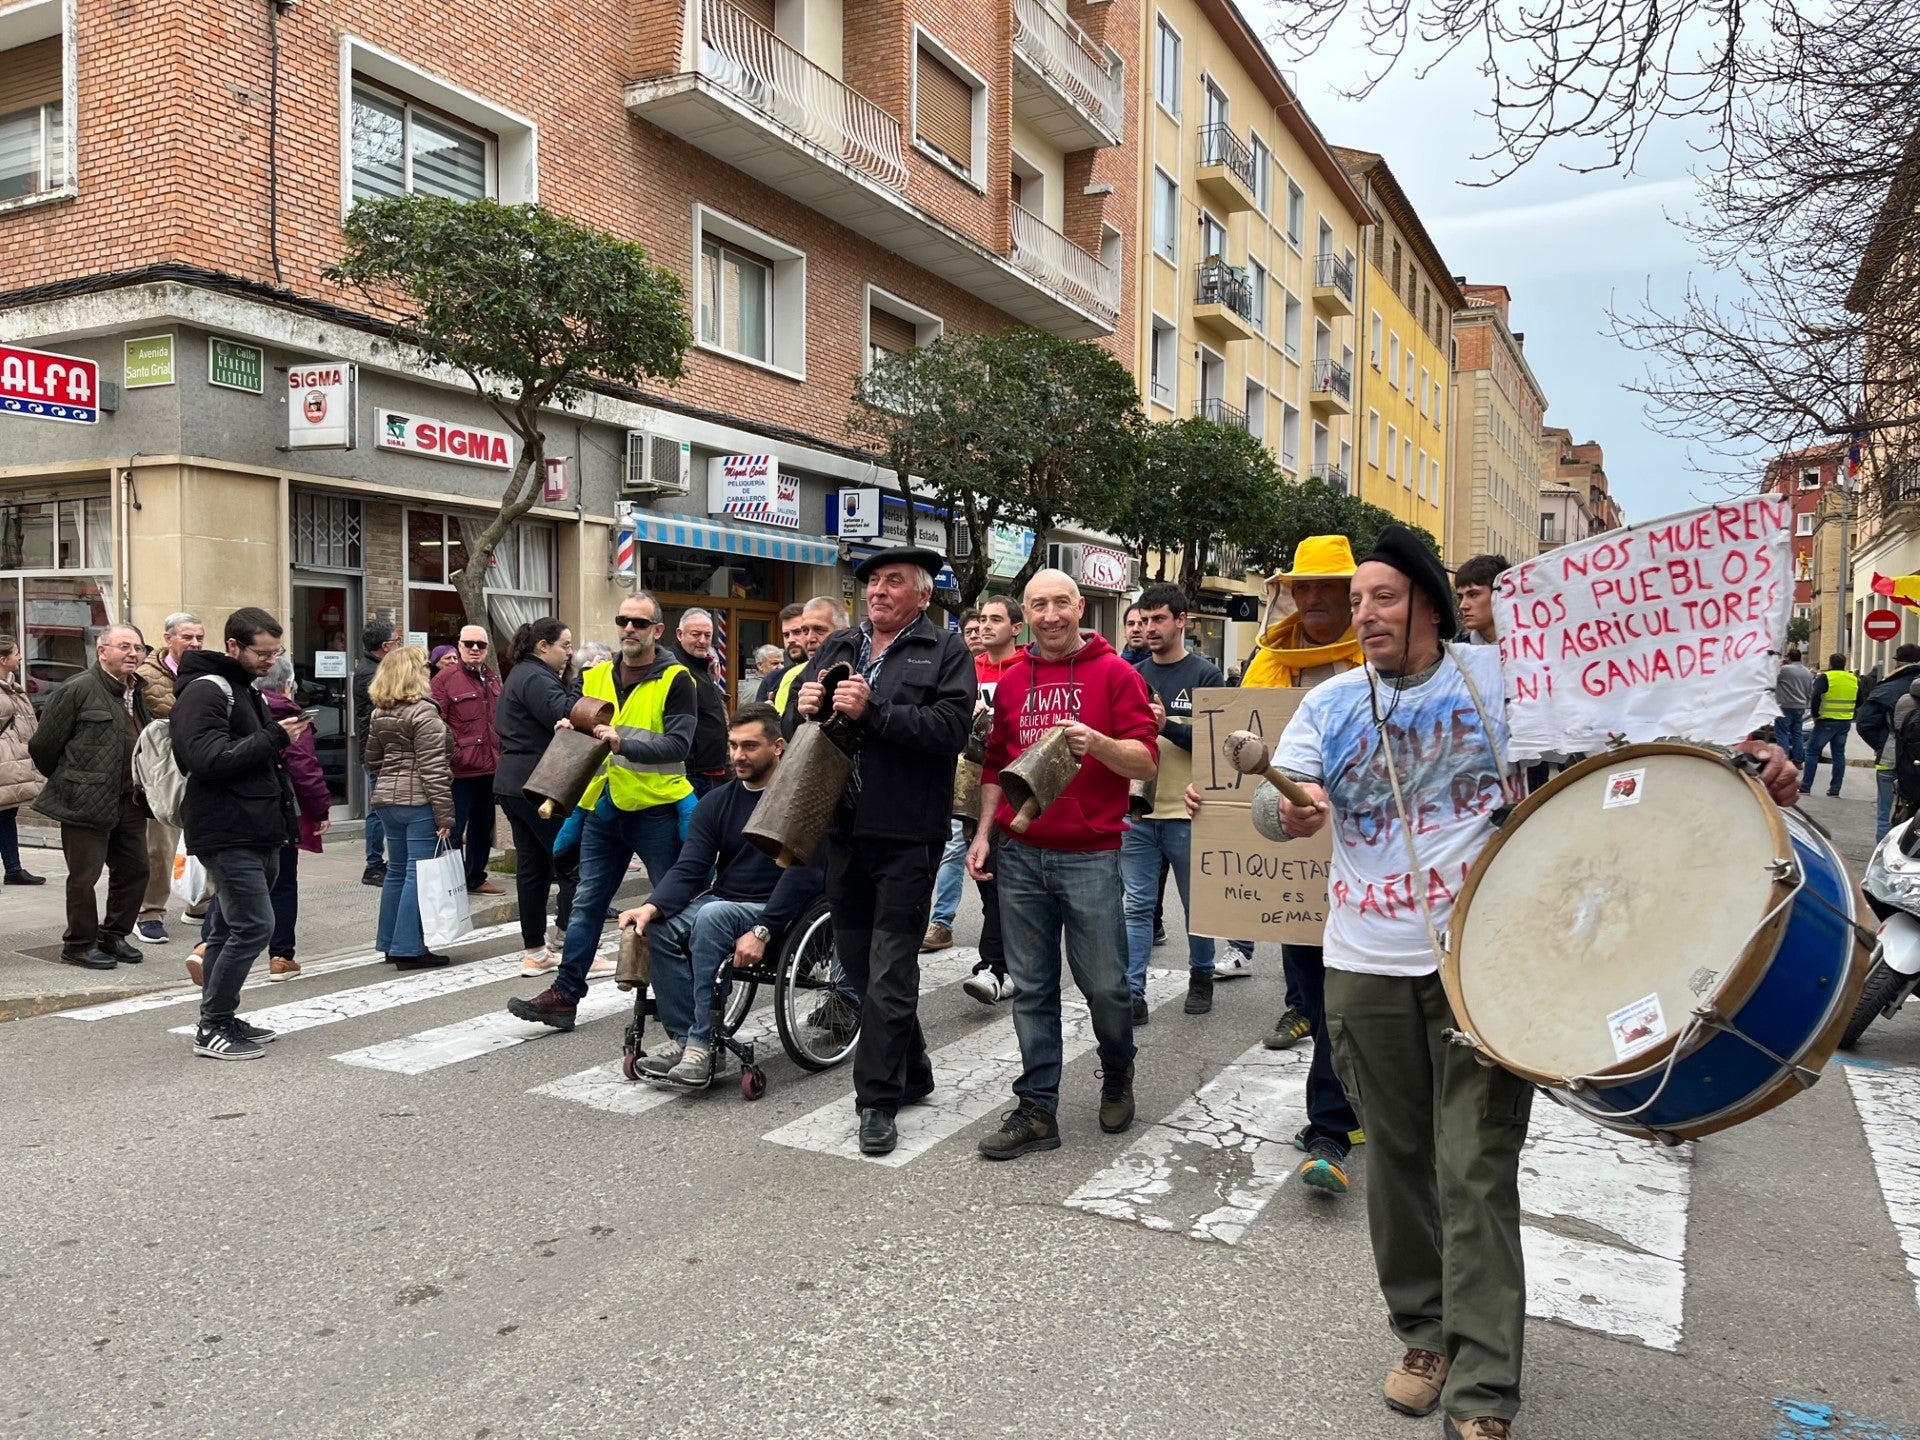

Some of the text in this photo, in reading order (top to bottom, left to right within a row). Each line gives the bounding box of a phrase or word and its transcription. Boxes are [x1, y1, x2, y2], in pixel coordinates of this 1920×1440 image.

[139, 346, 169, 360] Avenida
[236, 347, 256, 361] Calle
[126, 362, 172, 380] Santo Grial
[218, 356, 257, 375] GENERAL
[1, 356, 91, 402] ALFA
[216, 368, 259, 389] LASHERAS
[289, 369, 343, 389] SIGMA
[415, 423, 509, 464] SIGMA
[724, 465, 768, 479] Miguel Ceñal
[726, 495, 767, 503] CABALLEROS
[919, 528, 939, 543] Estado
[1500, 500, 1785, 600] SE NOS MUEREN
[1092, 561, 1114, 582] ISA
[1511, 544, 1772, 630] LOS PUEBLOS
[1581, 617, 1772, 697] GANADEROS
[1021, 687, 1082, 714] ALWAYS
[1020, 713, 1050, 728] BELIEVE
[1052, 712, 1062, 725] IN
[1019, 727, 1049, 745] IMPO
[1282, 891, 1305, 903] ES
[1261, 911, 1323, 924] DEMAS
